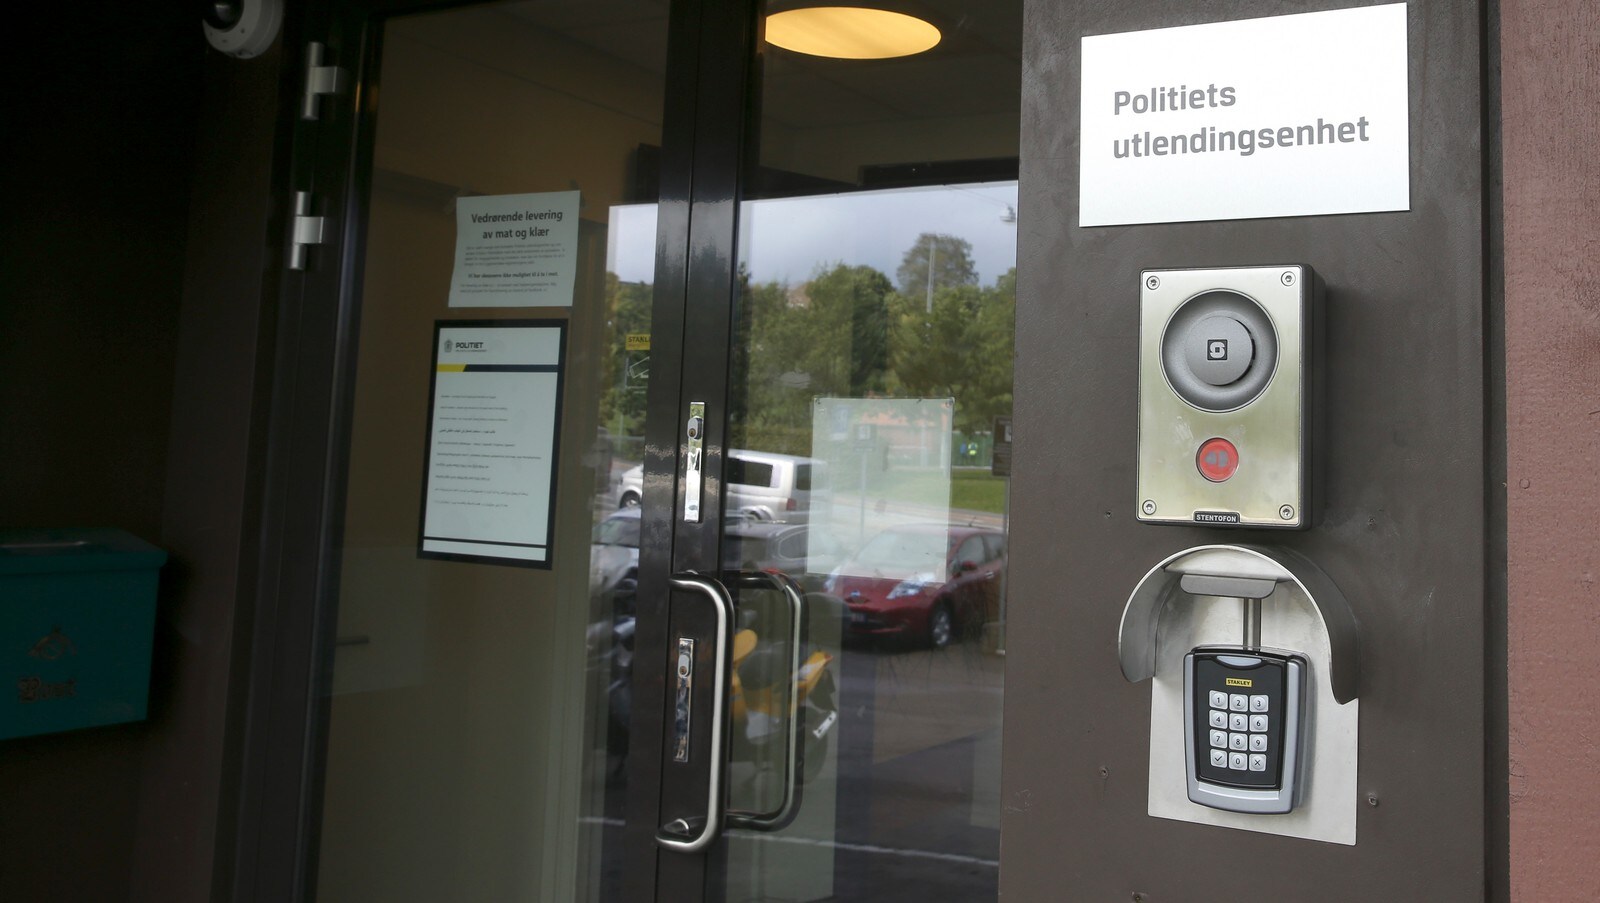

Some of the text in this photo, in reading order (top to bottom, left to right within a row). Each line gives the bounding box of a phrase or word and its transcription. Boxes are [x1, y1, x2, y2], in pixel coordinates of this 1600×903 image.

[1114, 83, 1237, 116] Politiets
[1113, 116, 1370, 159] utlendingsenhet
[471, 209, 563, 224] Vedrørende levering
[482, 226, 550, 240] av mat og klær
[628, 335, 649, 343] STANL
[1196, 514, 1237, 522] STENTOFON
